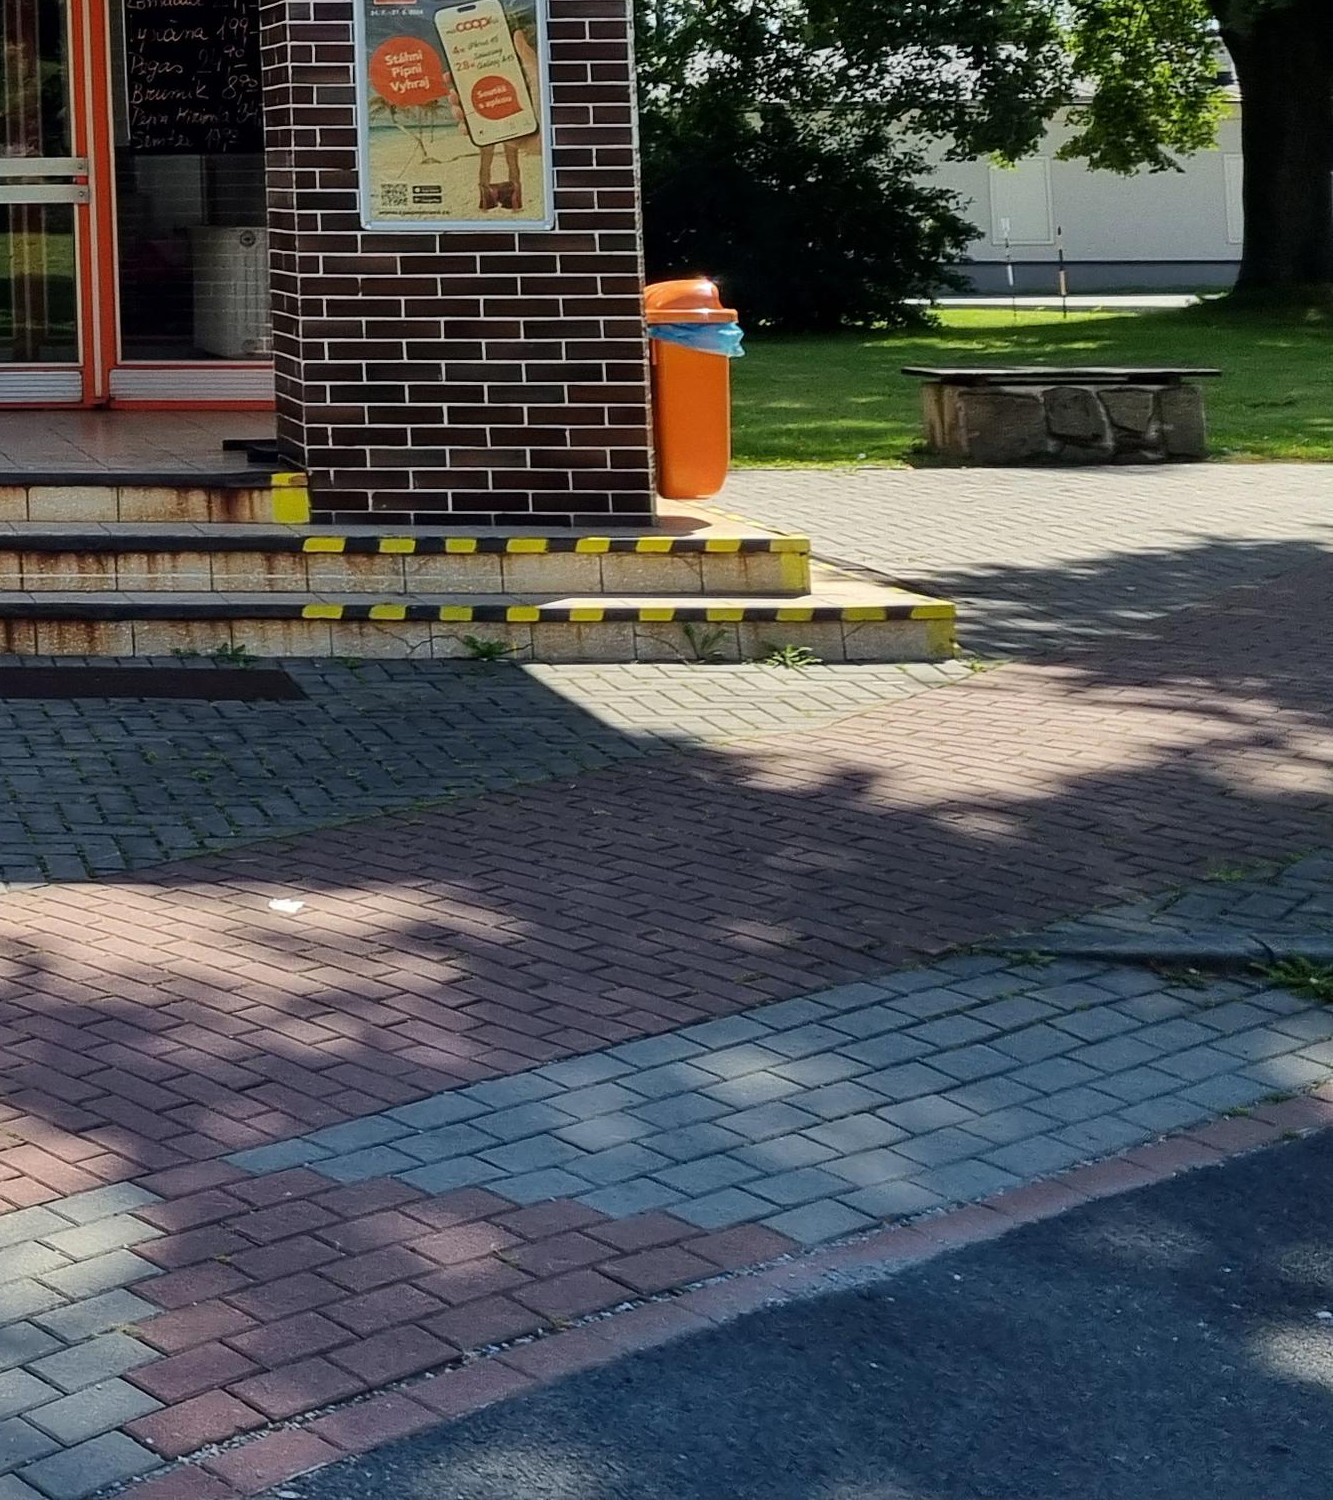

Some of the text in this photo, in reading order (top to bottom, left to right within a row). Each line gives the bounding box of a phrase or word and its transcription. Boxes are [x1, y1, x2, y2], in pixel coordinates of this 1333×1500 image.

[384, 49, 423, 66] Stáhni
[391, 62, 422, 78] Pípni
[389, 76, 430, 94] Vyhraj
